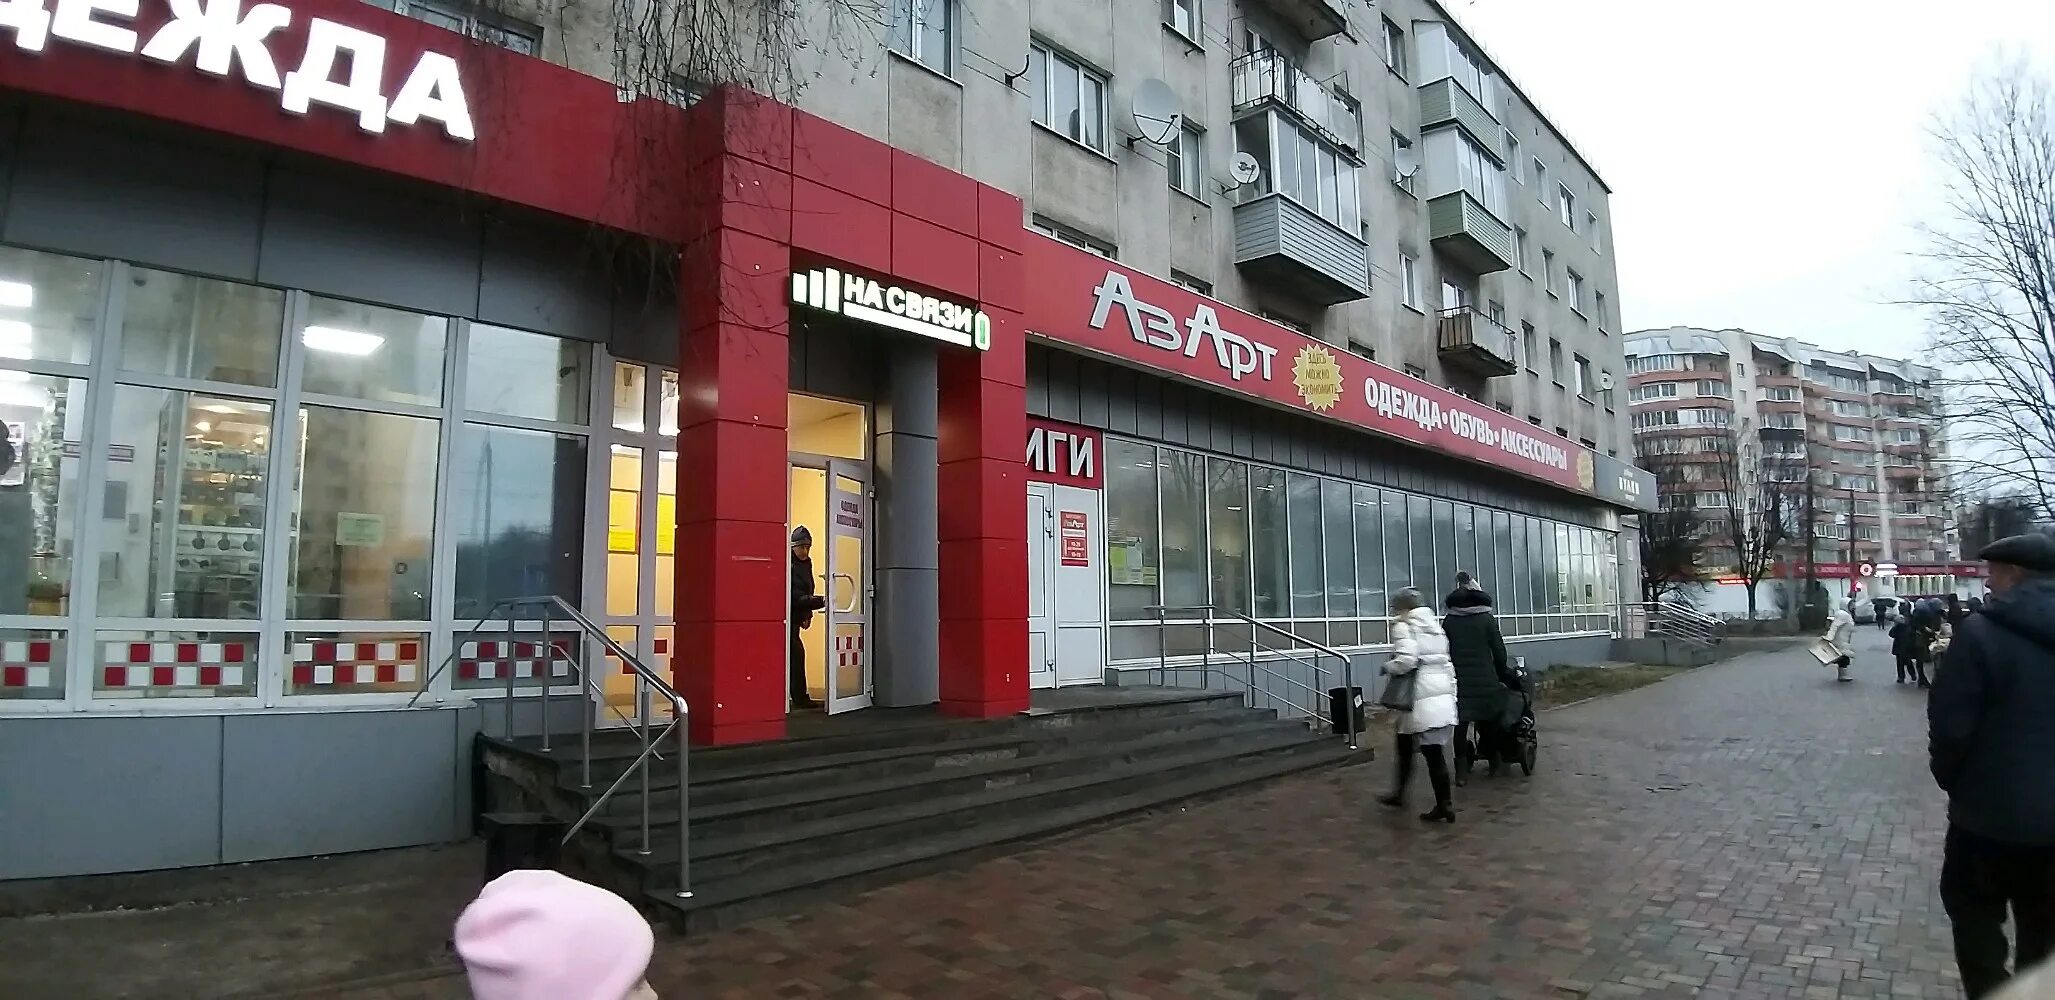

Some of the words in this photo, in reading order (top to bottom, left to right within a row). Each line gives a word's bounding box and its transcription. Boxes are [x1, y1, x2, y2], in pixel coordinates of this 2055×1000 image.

[844, 272, 884, 310] НА
[886, 286, 972, 333] СВЯЗИ
[1364, 377, 1443, 432] ОДЕЖДА
[1449, 408, 1495, 446] ОБУВЬ
[1501, 427, 1568, 471] АКСЕССУАРЫ
